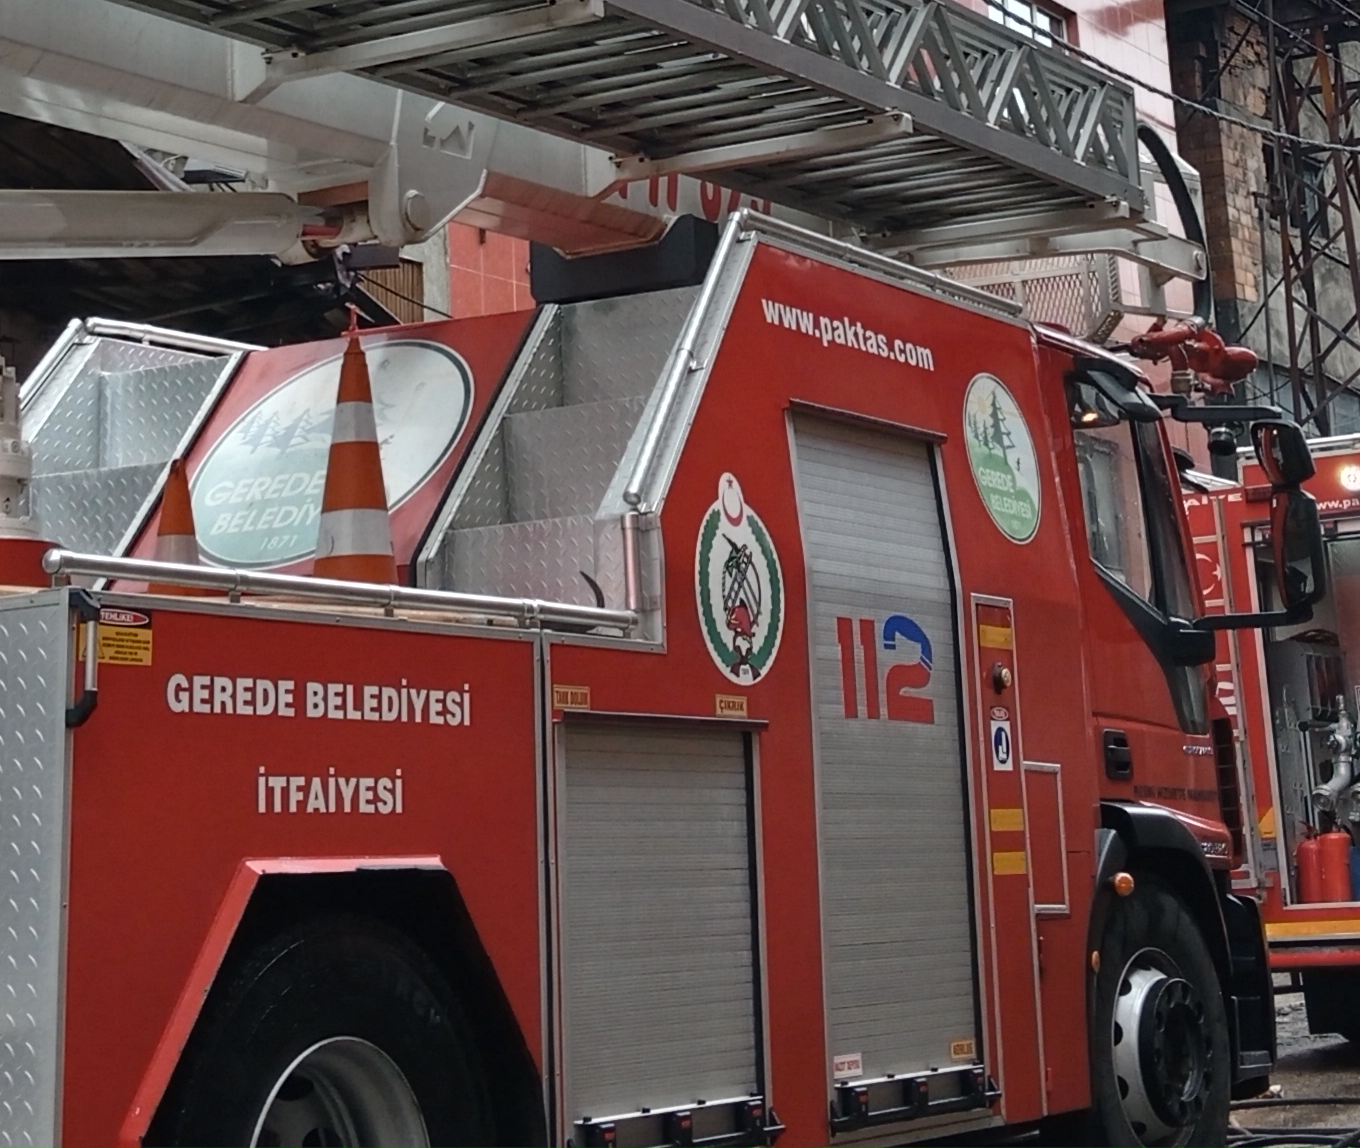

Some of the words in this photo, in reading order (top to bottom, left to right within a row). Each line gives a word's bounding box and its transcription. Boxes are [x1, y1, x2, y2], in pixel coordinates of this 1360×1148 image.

[761, 298, 934, 371] www.paktas.com
[204, 469, 327, 507] GEREDE
[978, 466, 1015, 493] GEREDE
[990, 493, 1033, 520] BELEDİYESİ
[260, 534, 298, 551] 1871
[836, 614, 934, 725] 112
[166, 673, 296, 718] GEREDE
[306, 677, 472, 727] BELEDİYESİ
[256, 766, 404, 814] İTFAİYESİ
